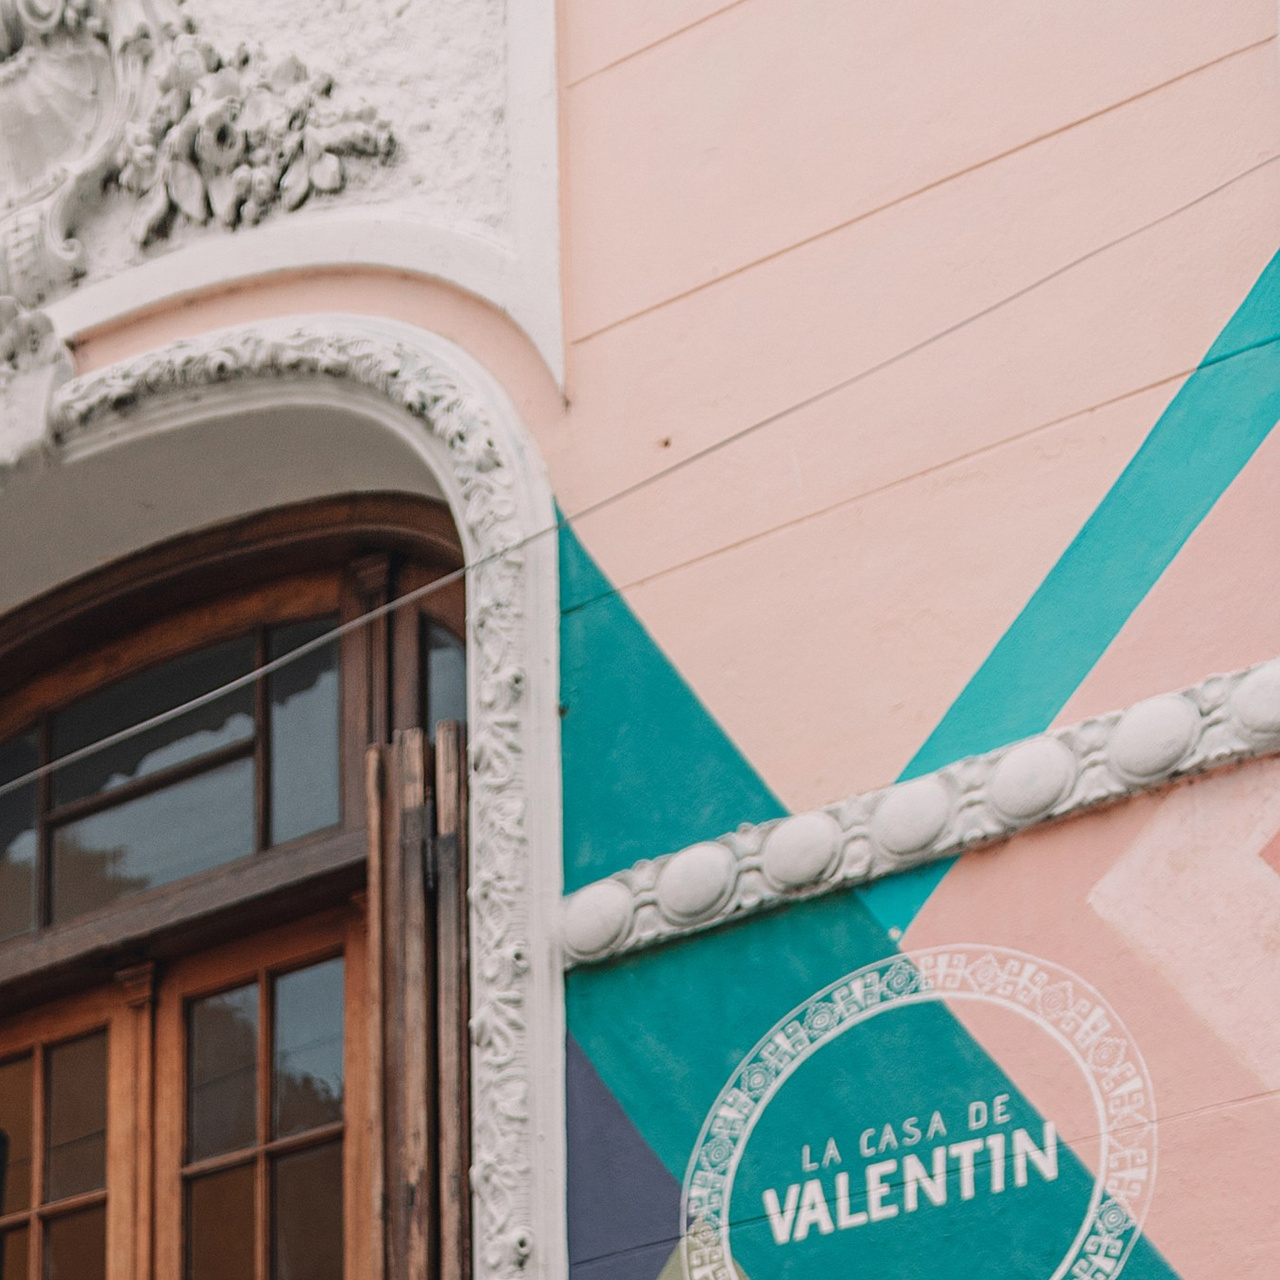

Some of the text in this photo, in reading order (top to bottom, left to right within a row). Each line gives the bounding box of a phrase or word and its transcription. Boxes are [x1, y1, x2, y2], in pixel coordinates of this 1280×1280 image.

[801, 1093, 1012, 1173] LA CASA DE
